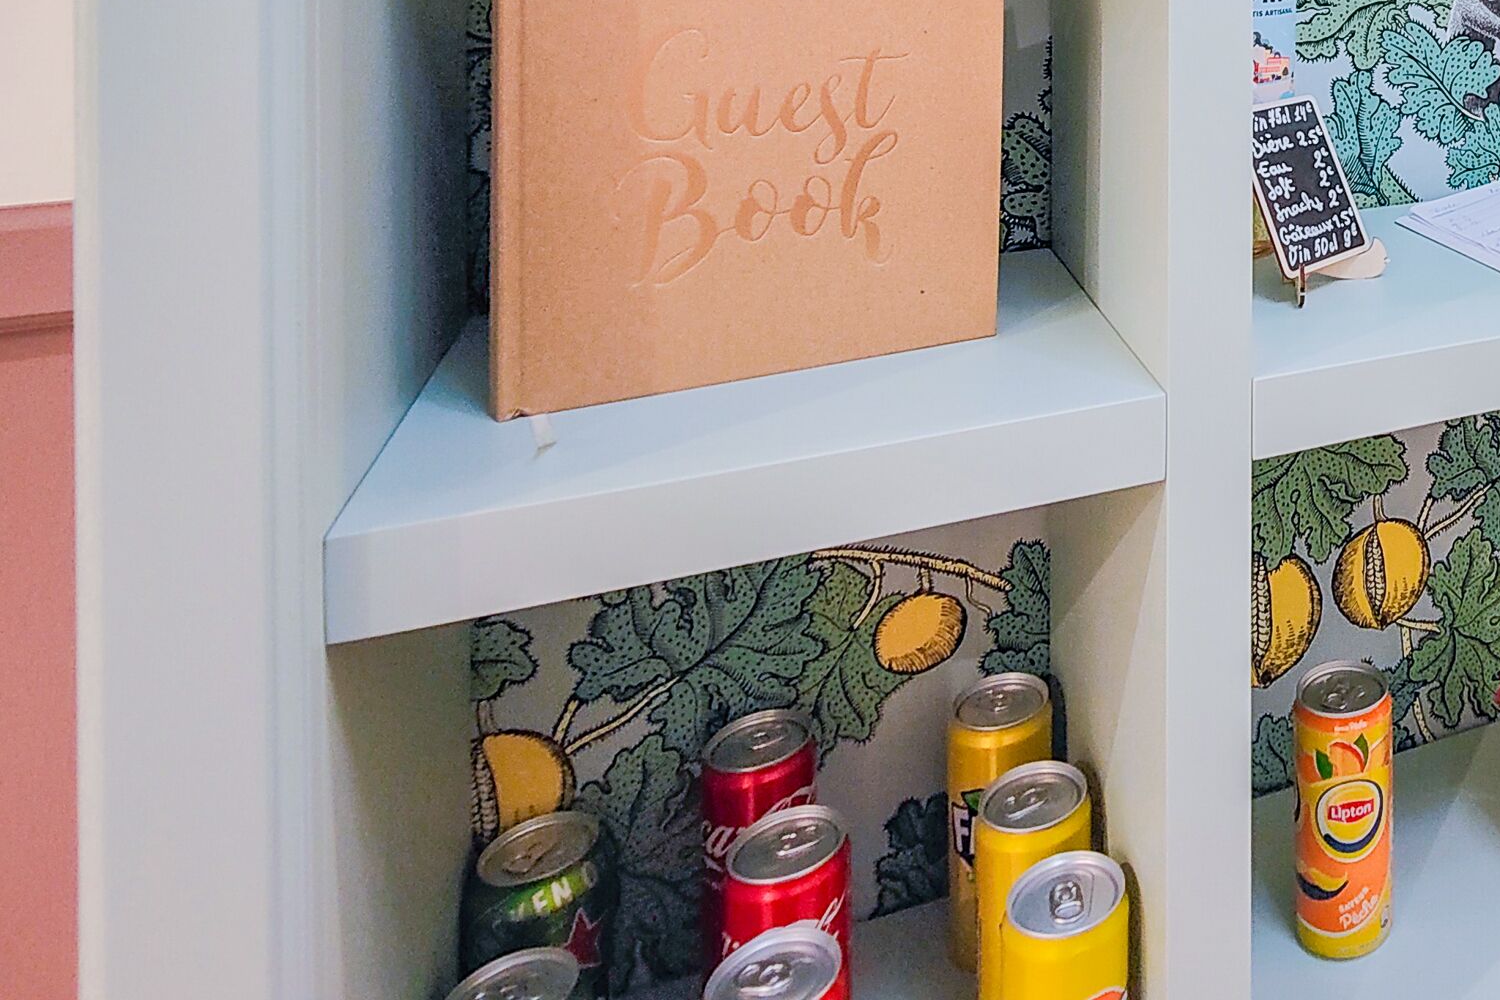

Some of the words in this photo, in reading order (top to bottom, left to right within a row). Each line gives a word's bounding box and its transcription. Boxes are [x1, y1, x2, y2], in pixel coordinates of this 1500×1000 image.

[627, 23, 910, 165] Guest
[1257, 160, 1293, 178] Eau
[615, 130, 899, 291] Book
[1279, 219, 1334, 246] Gâteaux
[1288, 244, 1312, 268] Vin
[1331, 801, 1373, 823] Lipton
